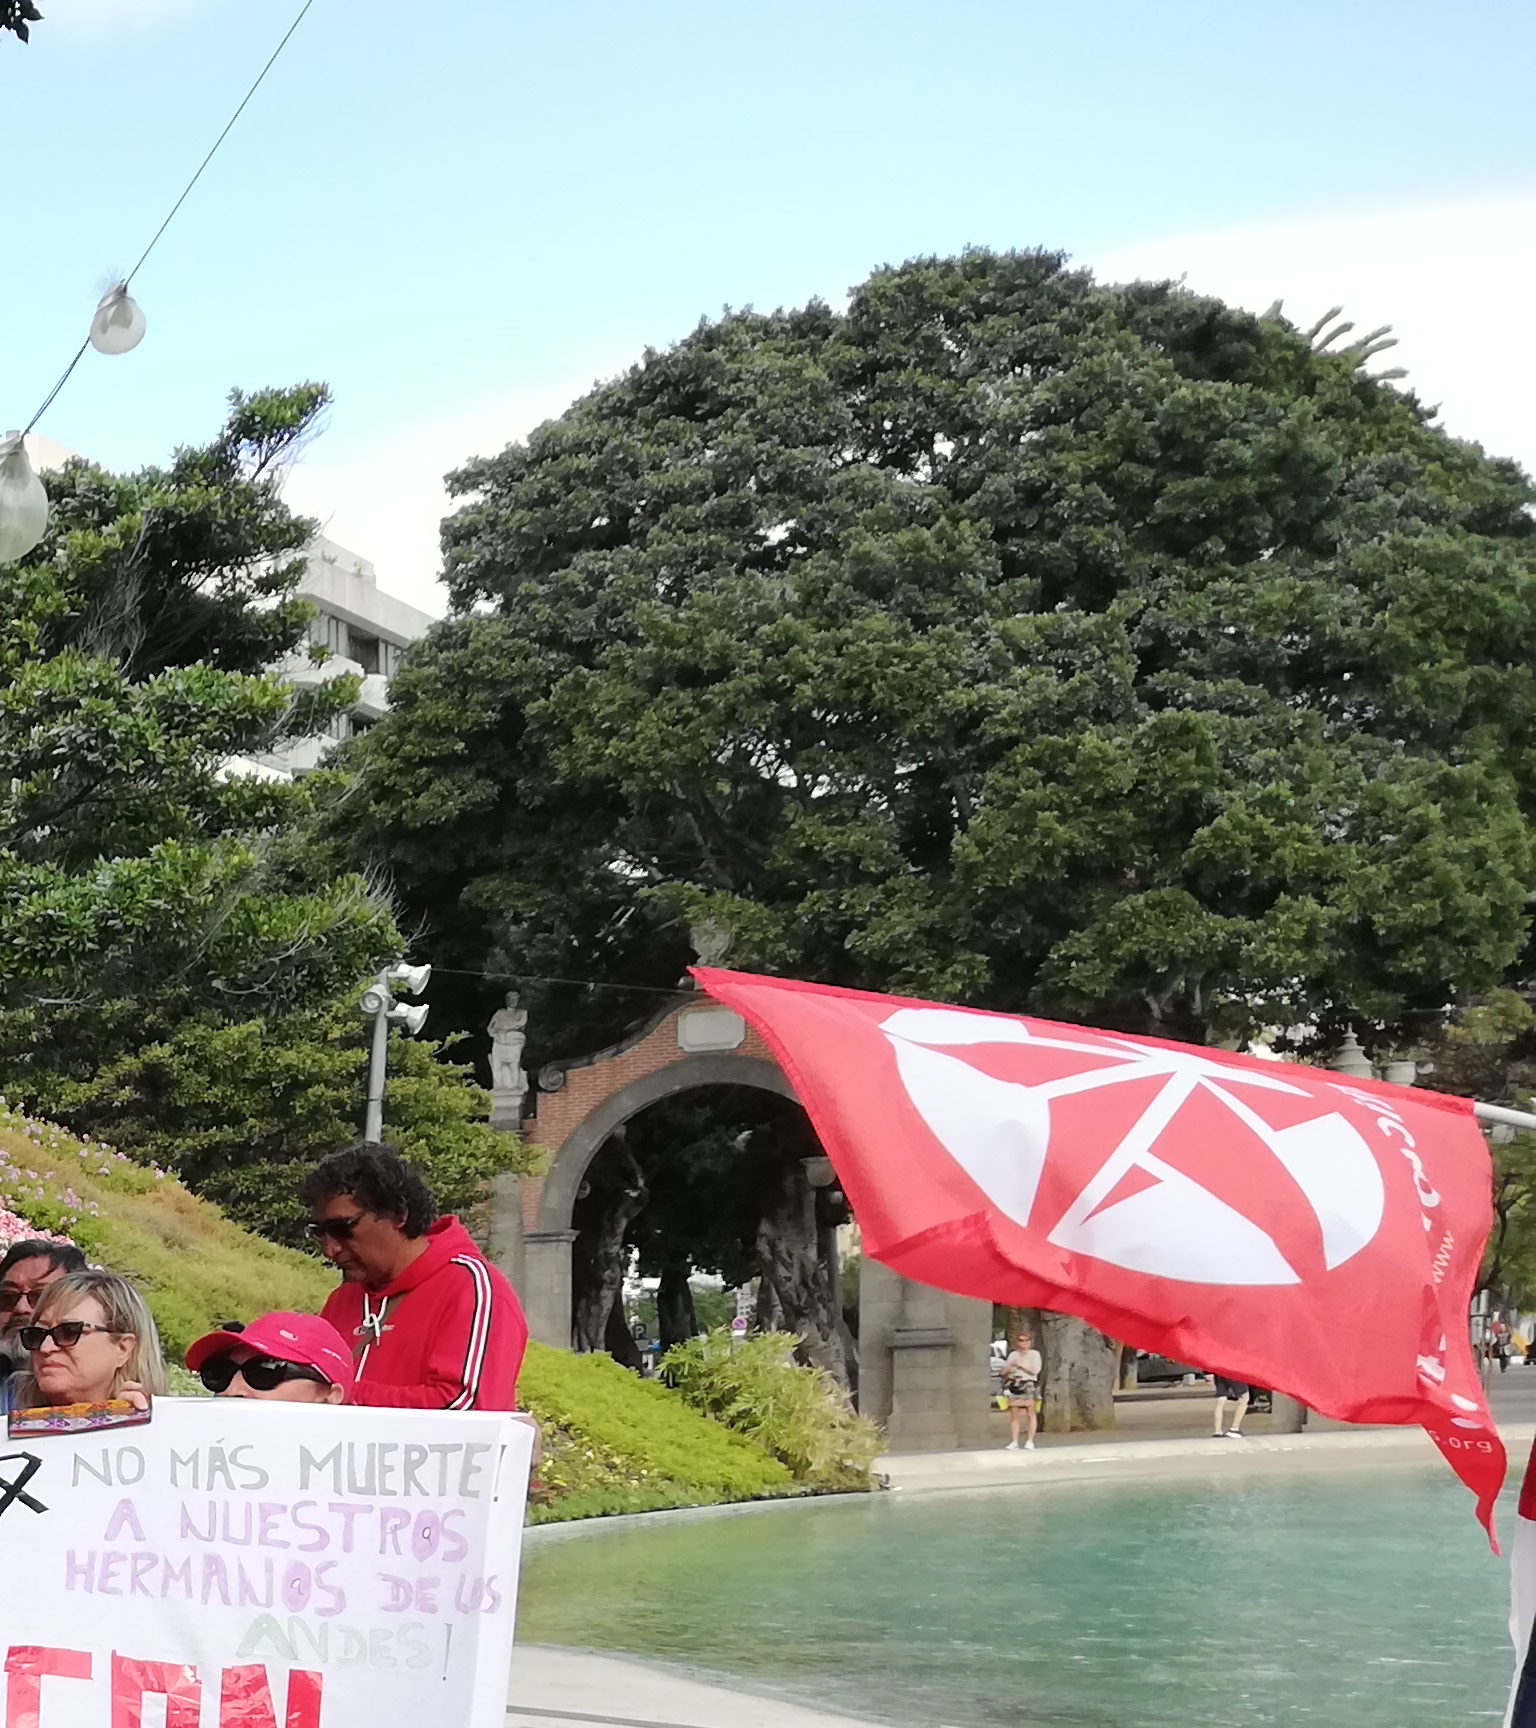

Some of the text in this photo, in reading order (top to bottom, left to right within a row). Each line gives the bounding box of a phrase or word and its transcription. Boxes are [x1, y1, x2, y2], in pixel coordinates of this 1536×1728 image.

[71, 1446, 146, 1488] NO
[170, 1437, 270, 1491] MÁS
[103, 1498, 147, 1542] A
[376, 1572, 442, 1615] DE
